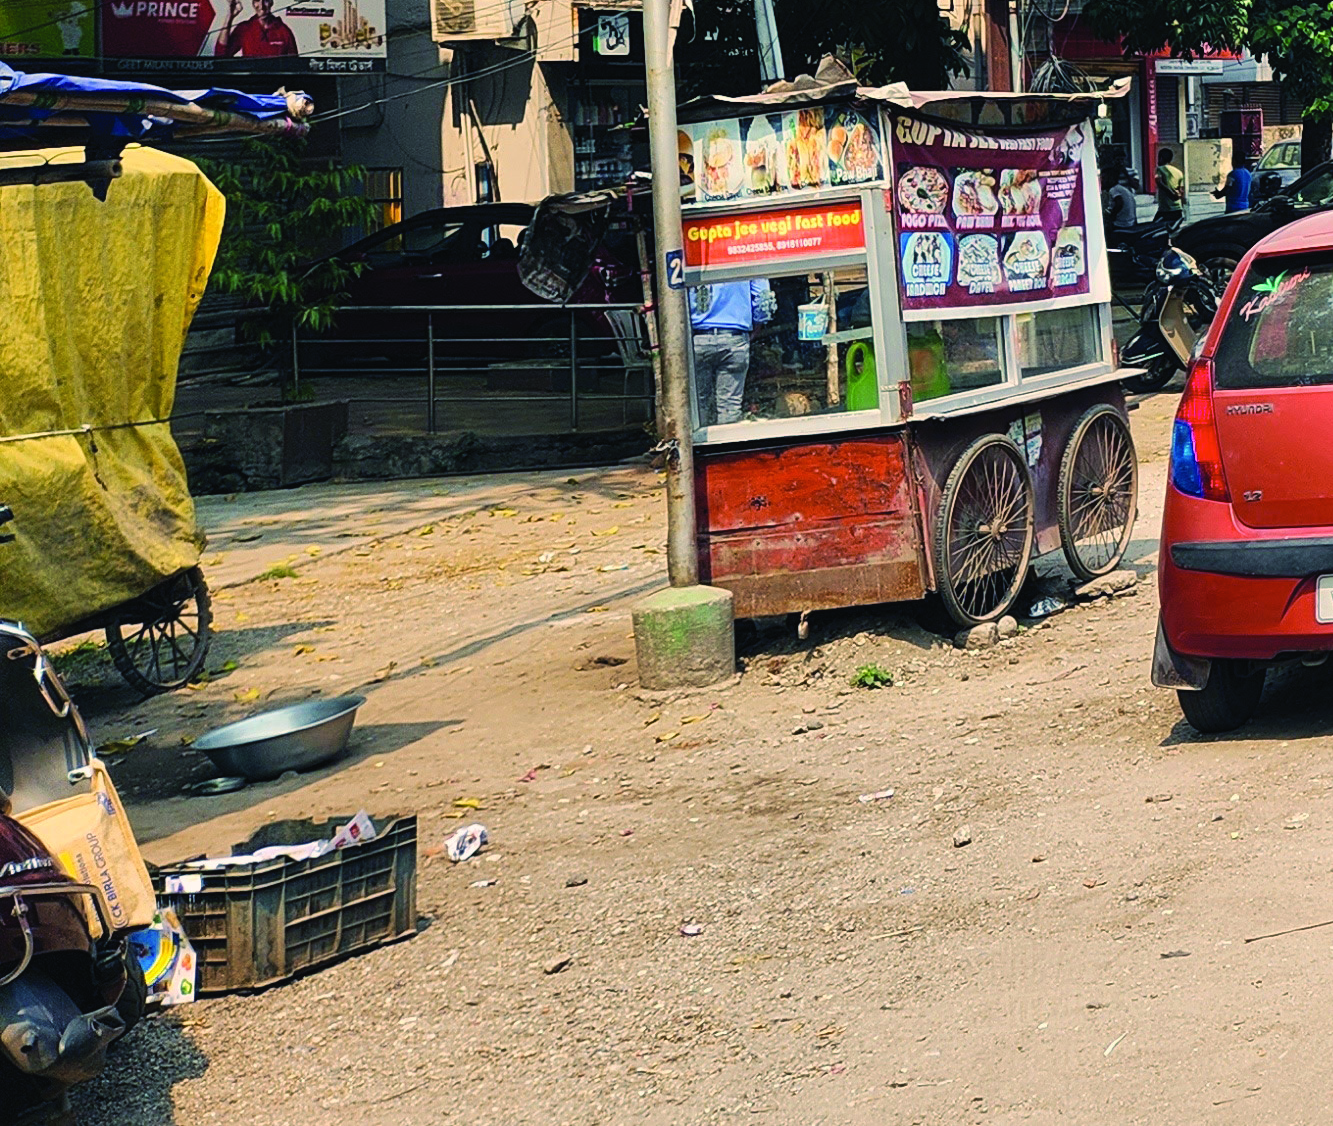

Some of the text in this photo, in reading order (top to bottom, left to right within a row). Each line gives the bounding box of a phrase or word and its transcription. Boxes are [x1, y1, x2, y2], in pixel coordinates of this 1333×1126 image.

[136, 2, 199, 18] PRINCE
[836, 166, 855, 182] Paw
[688, 210, 860, 243] Gupta jee vegi fast food
[1226, 402, 1275, 415] HYUNDAI
[86, 832, 107, 868] GROUP
[76, 853, 92, 886] olutions
[100, 868, 118, 902] BIRLA
